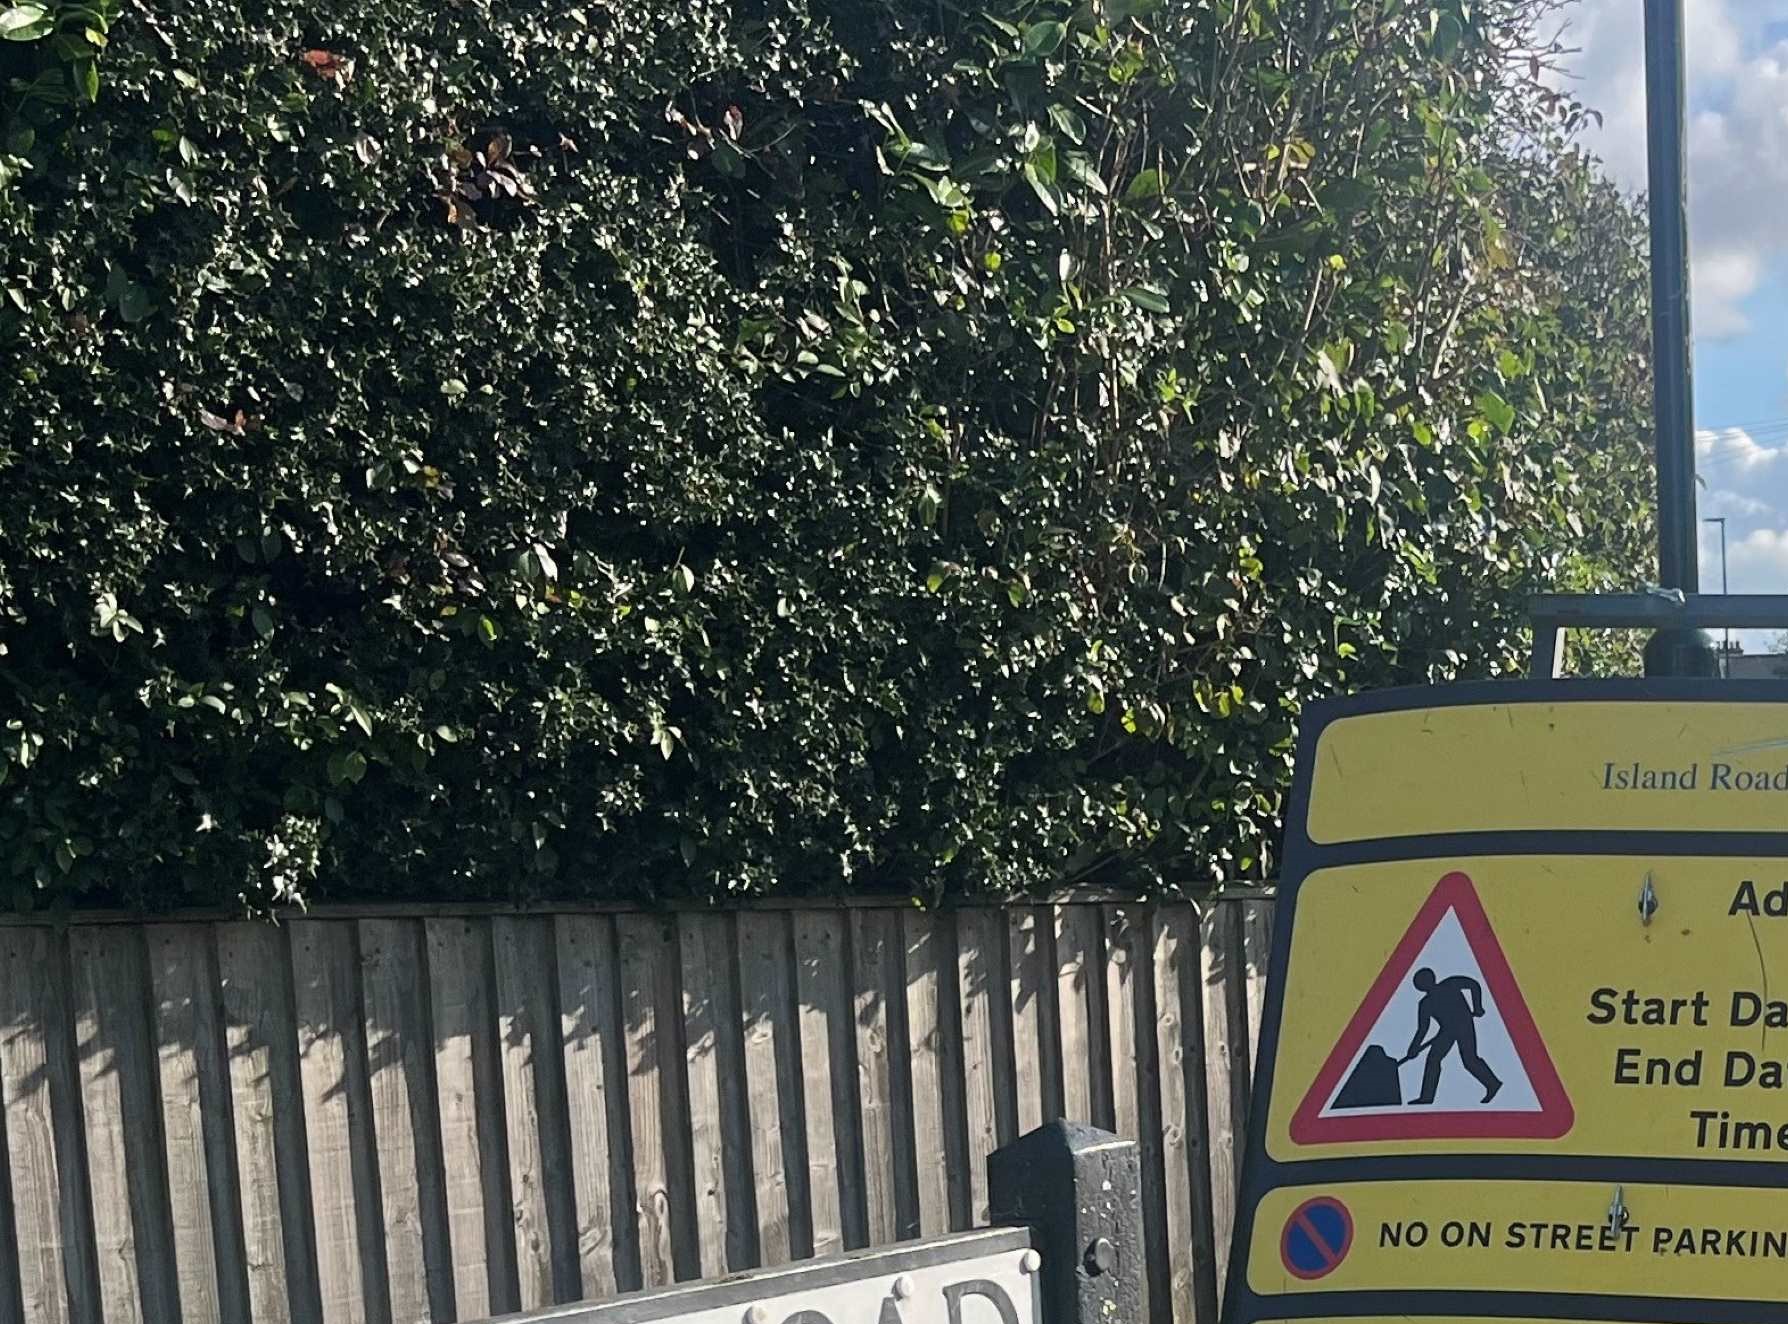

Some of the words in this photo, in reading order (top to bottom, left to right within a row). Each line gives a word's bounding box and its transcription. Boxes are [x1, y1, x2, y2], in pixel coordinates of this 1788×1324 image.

[1602, 762, 1698, 790] Island
[1586, 987, 1710, 1027] Start
[1613, 1048, 1704, 1087] End
[1378, 1221, 1428, 1248] NO
[1439, 1220, 1493, 1248] ON
[1504, 1221, 1641, 1252] STREET
